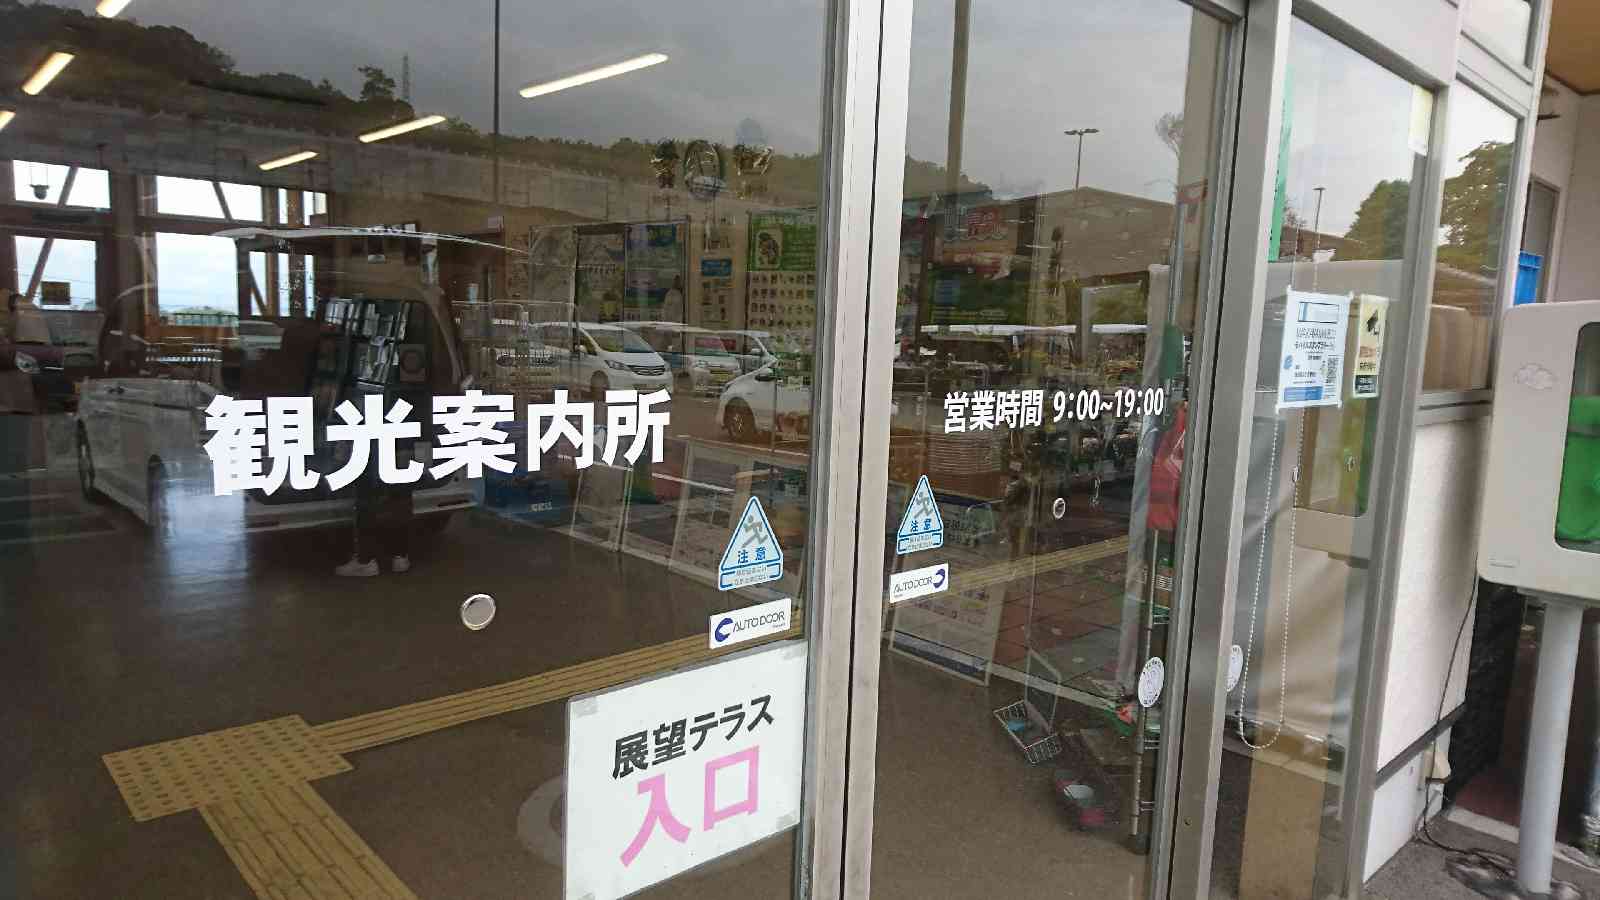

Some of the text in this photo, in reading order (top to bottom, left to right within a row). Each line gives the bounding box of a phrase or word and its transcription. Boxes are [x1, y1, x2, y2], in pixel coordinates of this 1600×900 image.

[203, 389, 671, 496] 観光案内所
[944, 389, 1043, 433] 営業時間
[738, 546, 766, 564] 注意
[612, 694, 774, 780] 展望テラス
[620, 745, 759, 867] 入口
